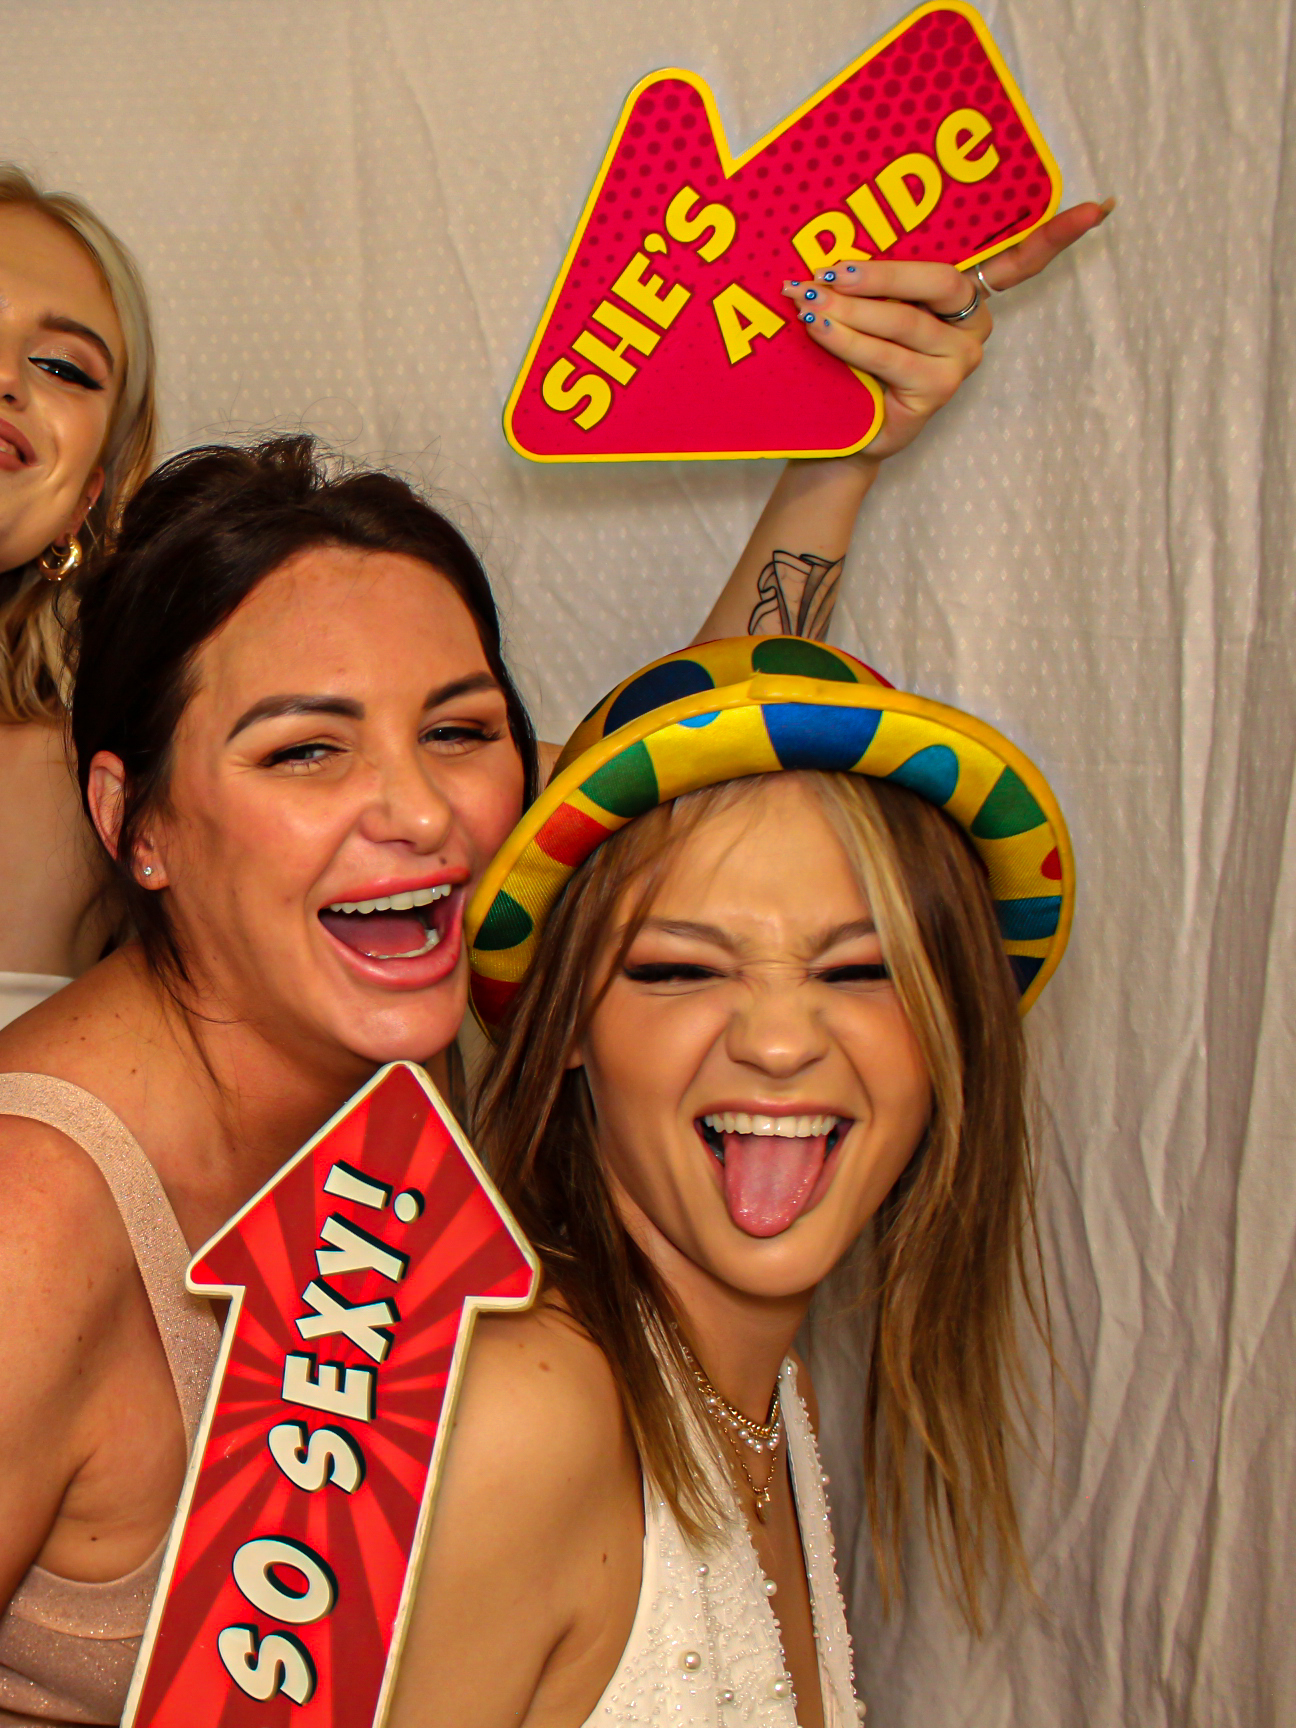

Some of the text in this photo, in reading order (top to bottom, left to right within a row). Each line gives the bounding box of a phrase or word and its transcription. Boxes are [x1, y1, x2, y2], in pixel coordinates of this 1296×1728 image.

[541, 185, 737, 431] SHE'S
[712, 283, 786, 365] A
[217, 1160, 425, 1706] SO SEXY!
